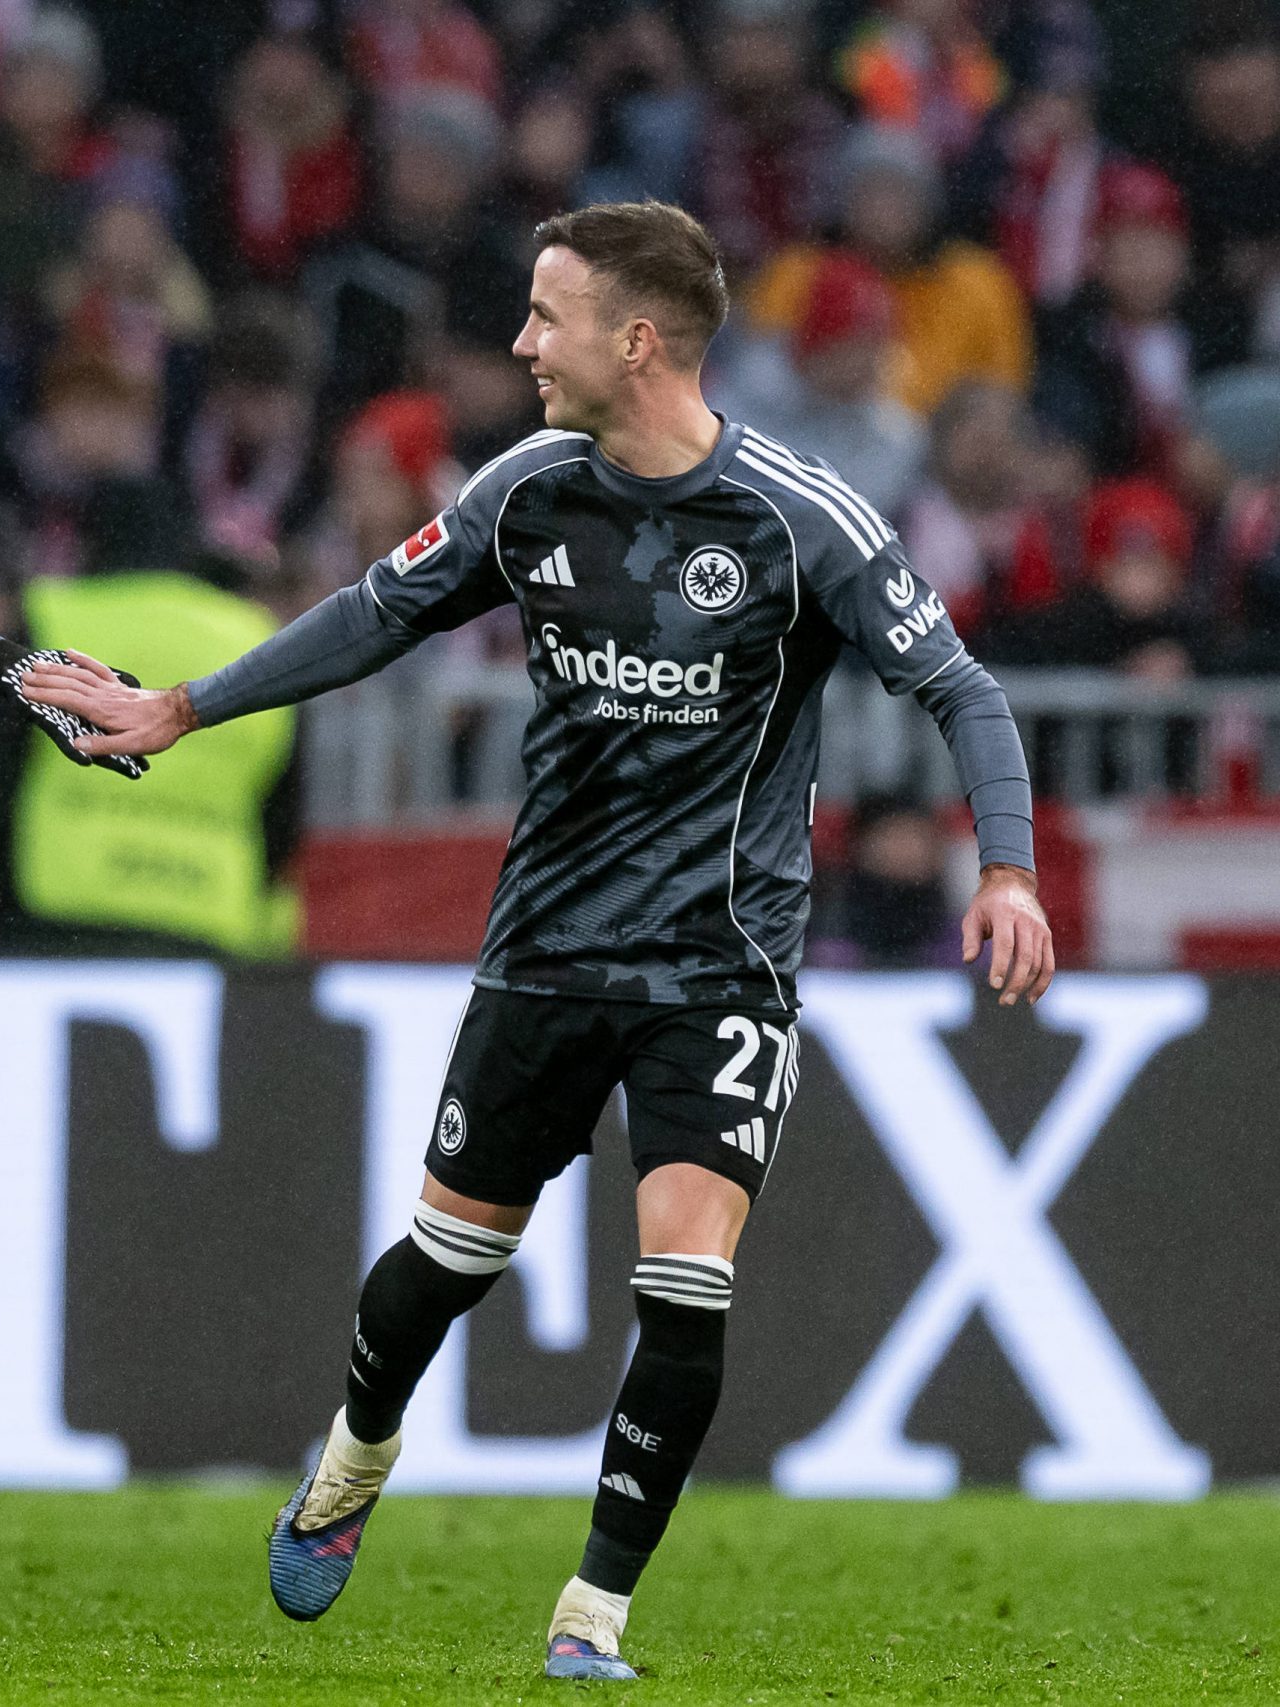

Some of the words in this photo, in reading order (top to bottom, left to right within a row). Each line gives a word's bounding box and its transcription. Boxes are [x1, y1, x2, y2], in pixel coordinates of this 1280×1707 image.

[541, 623, 724, 698] indeed
[593, 696, 640, 720] Jobs
[644, 703, 719, 724] finden
[712, 1015, 788, 1113] 27
[355, 1312, 383, 1370] GE
[616, 1412, 662, 1453] SGE
